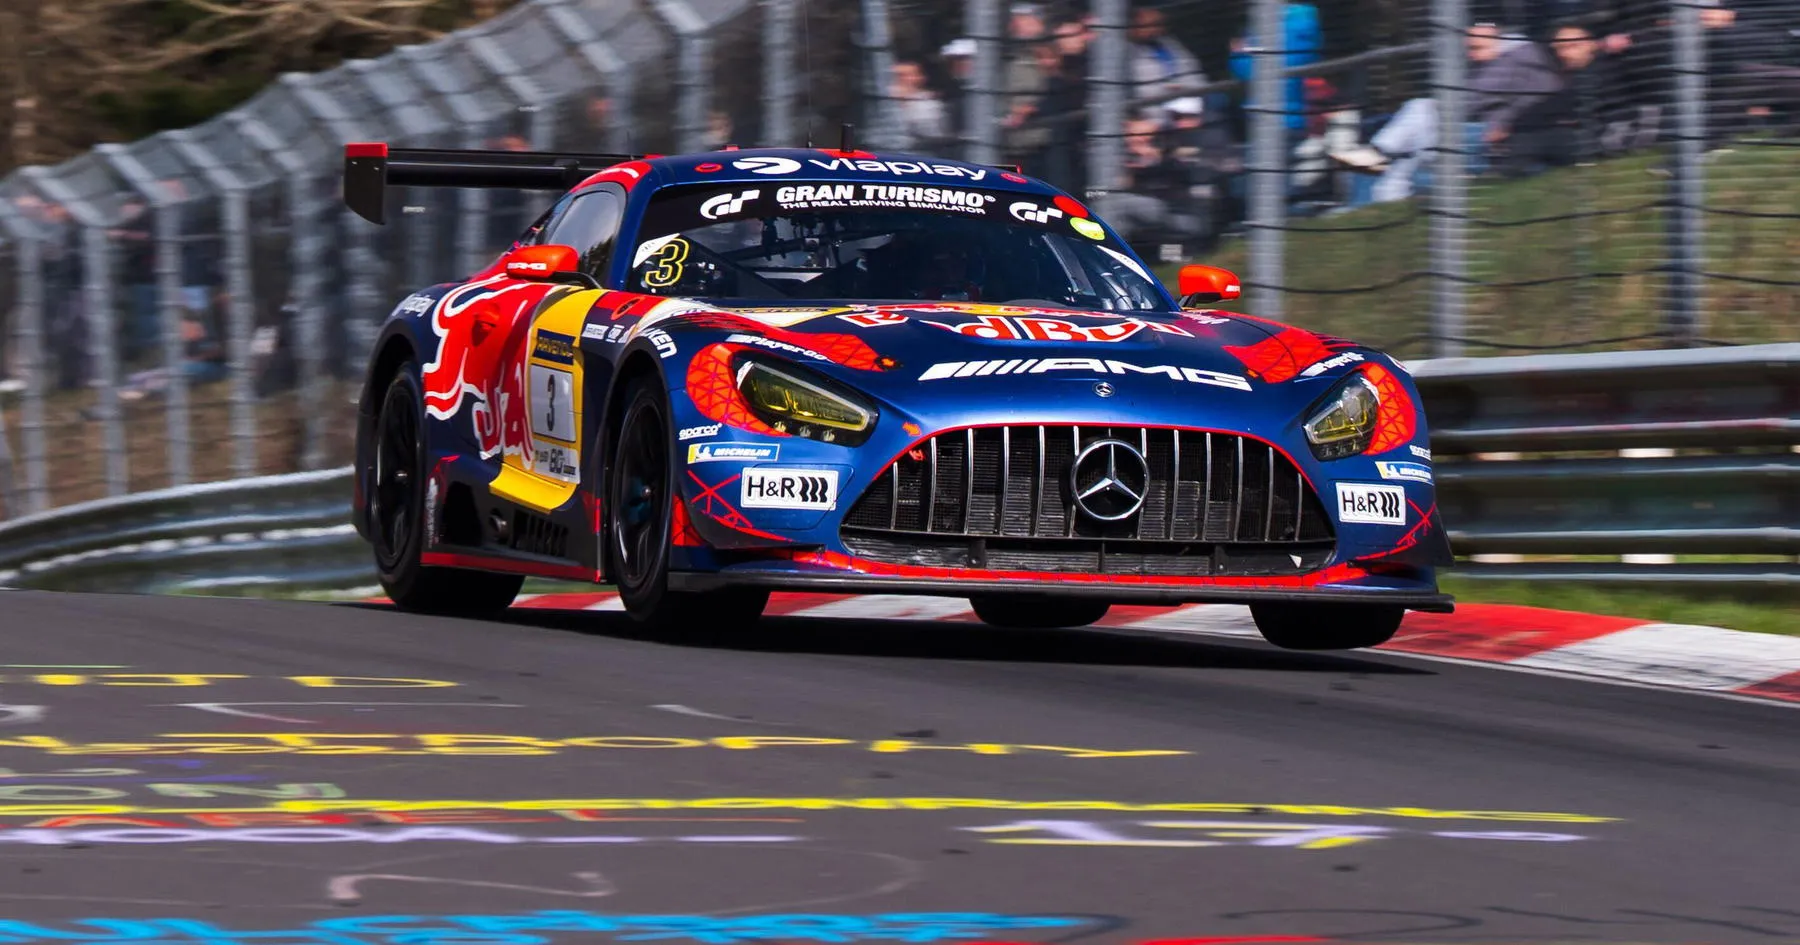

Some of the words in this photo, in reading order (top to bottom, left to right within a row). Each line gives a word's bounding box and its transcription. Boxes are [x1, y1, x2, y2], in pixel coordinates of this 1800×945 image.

[808, 158, 987, 181] viaplay
[776, 185, 851, 201] GRAN
[811, 199, 848, 208] REAL
[849, 199, 906, 208] DRIVING
[909, 201, 986, 215] SIMULATOR
[645, 238, 689, 287] 3
[1028, 358, 1253, 391] AMG
[546, 374, 556, 432] 3
[714, 447, 771, 457] MICHELIN
[747, 475, 795, 498] H&R
[1342, 490, 1380, 514] H&R
